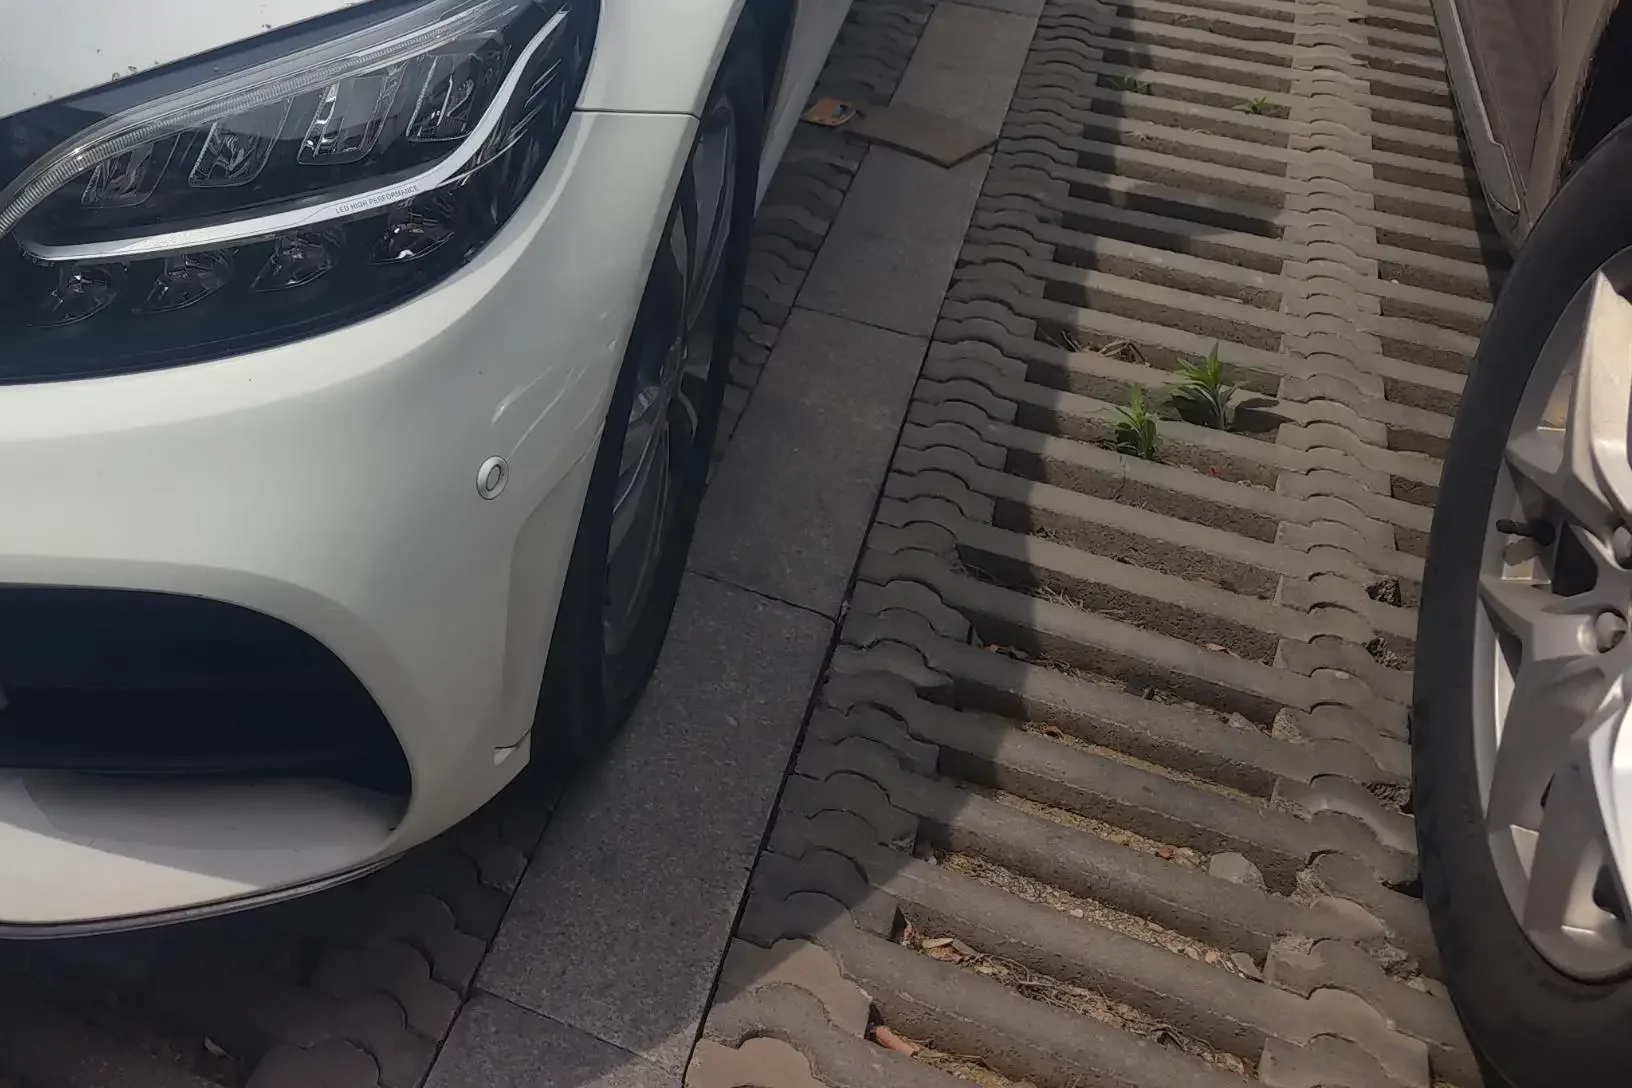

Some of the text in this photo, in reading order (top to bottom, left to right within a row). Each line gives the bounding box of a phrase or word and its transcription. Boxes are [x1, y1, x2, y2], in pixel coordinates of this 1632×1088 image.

[335, 185, 417, 214] LED HIGH PERFORMANCE
